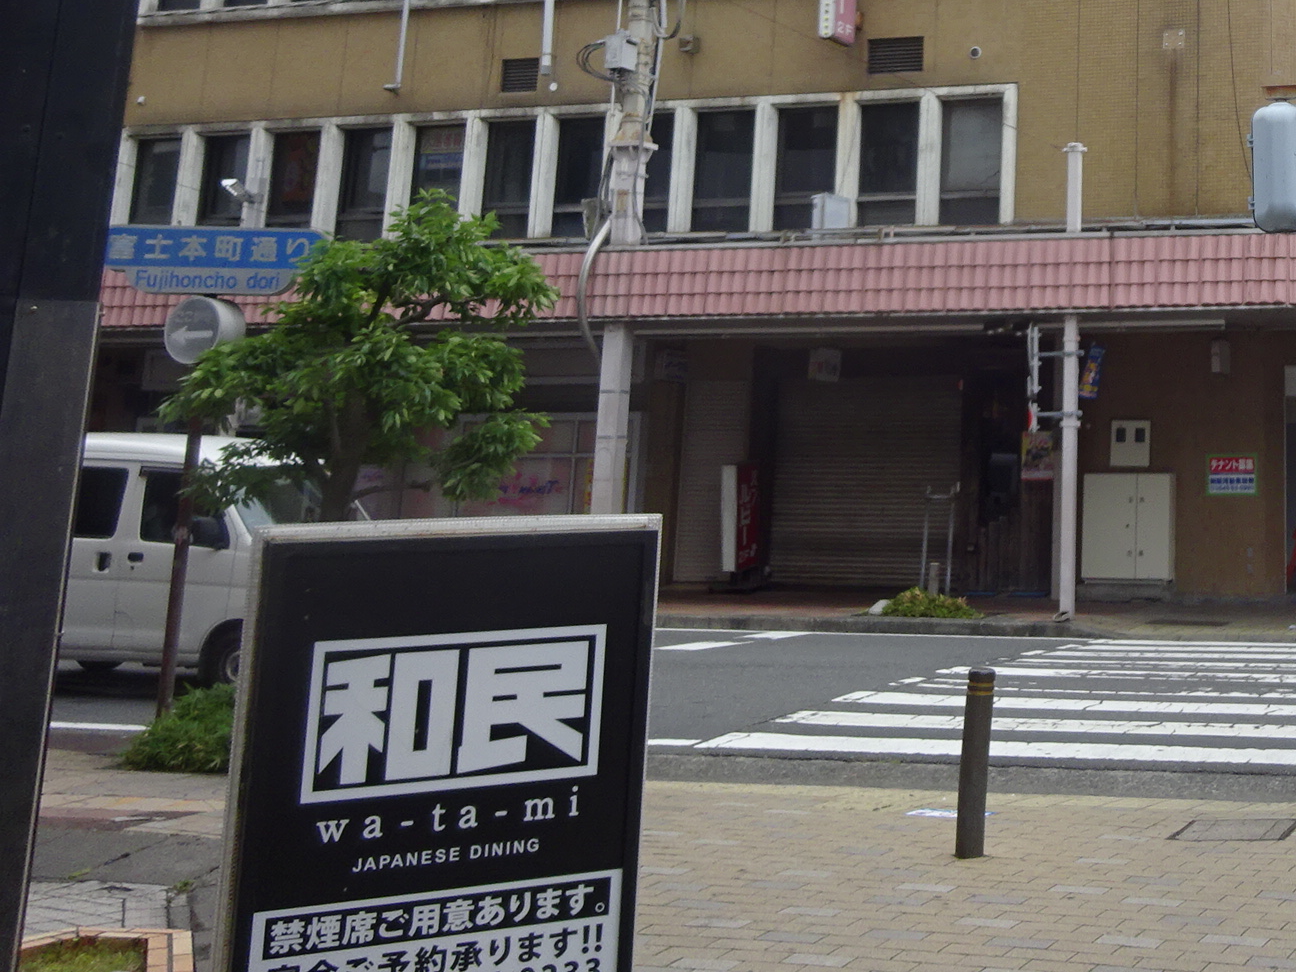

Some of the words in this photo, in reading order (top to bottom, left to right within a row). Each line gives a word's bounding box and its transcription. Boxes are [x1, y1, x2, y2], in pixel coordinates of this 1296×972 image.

[109, 233, 311, 263] 富士本町通り
[136, 270, 237, 290] Fujihoncho
[247, 272, 280, 289] dori
[318, 640, 589, 785] 和民
[352, 846, 460, 873] JAPANESE
[470, 837, 540, 857] DINING
[269, 883, 605, 955] 禁煙席ご用意あります。
[267, 923, 604, 972] ご予約承ります!!
